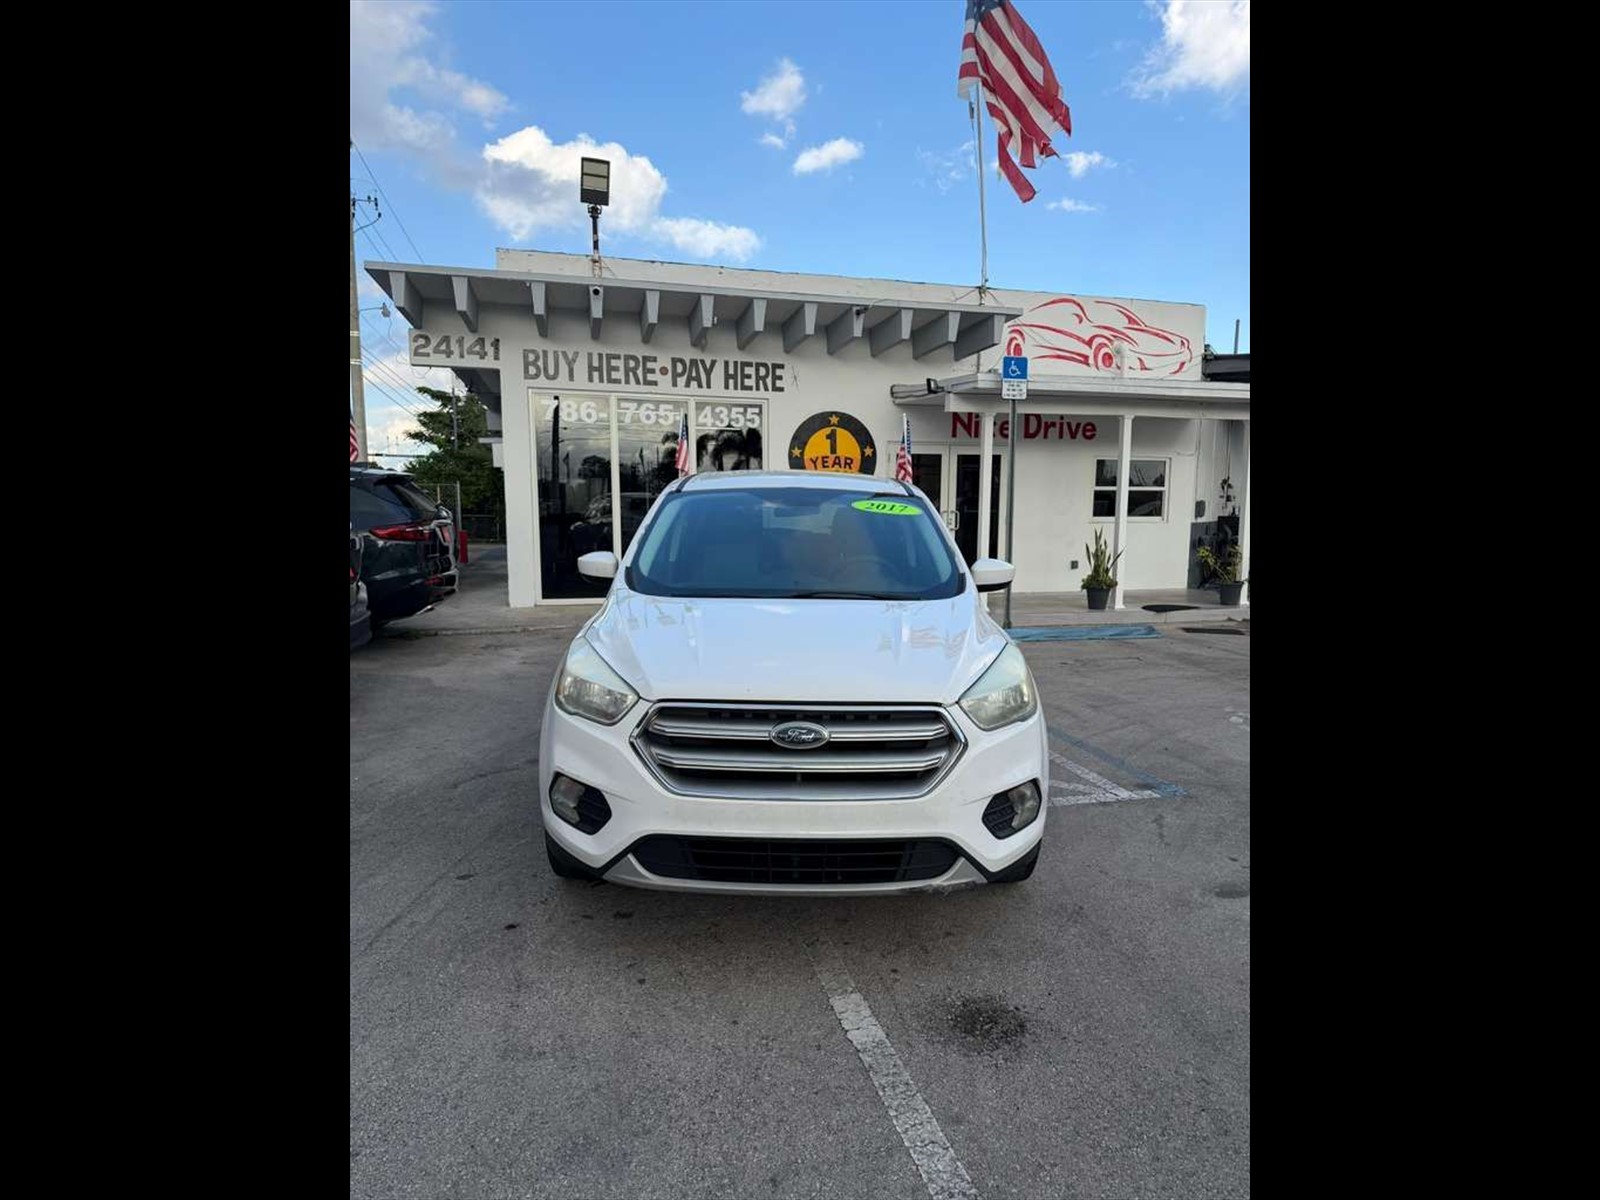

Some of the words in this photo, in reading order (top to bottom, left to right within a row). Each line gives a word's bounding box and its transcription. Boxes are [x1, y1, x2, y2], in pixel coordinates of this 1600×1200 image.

[412, 333, 500, 361] 24141
[522, 348, 580, 382] BUY
[587, 352, 658, 387] HERE
[670, 357, 717, 389] PAY
[723, 360, 785, 392] HERE
[698, 405, 761, 428] 4355
[951, 411, 1010, 439] Nie
[1023, 413, 1097, 440] Drive
[825, 428, 838, 455] 1
[809, 455, 854, 470] YEAR
[864, 502, 909, 513] 2017
[785, 728, 815, 742] Ford
